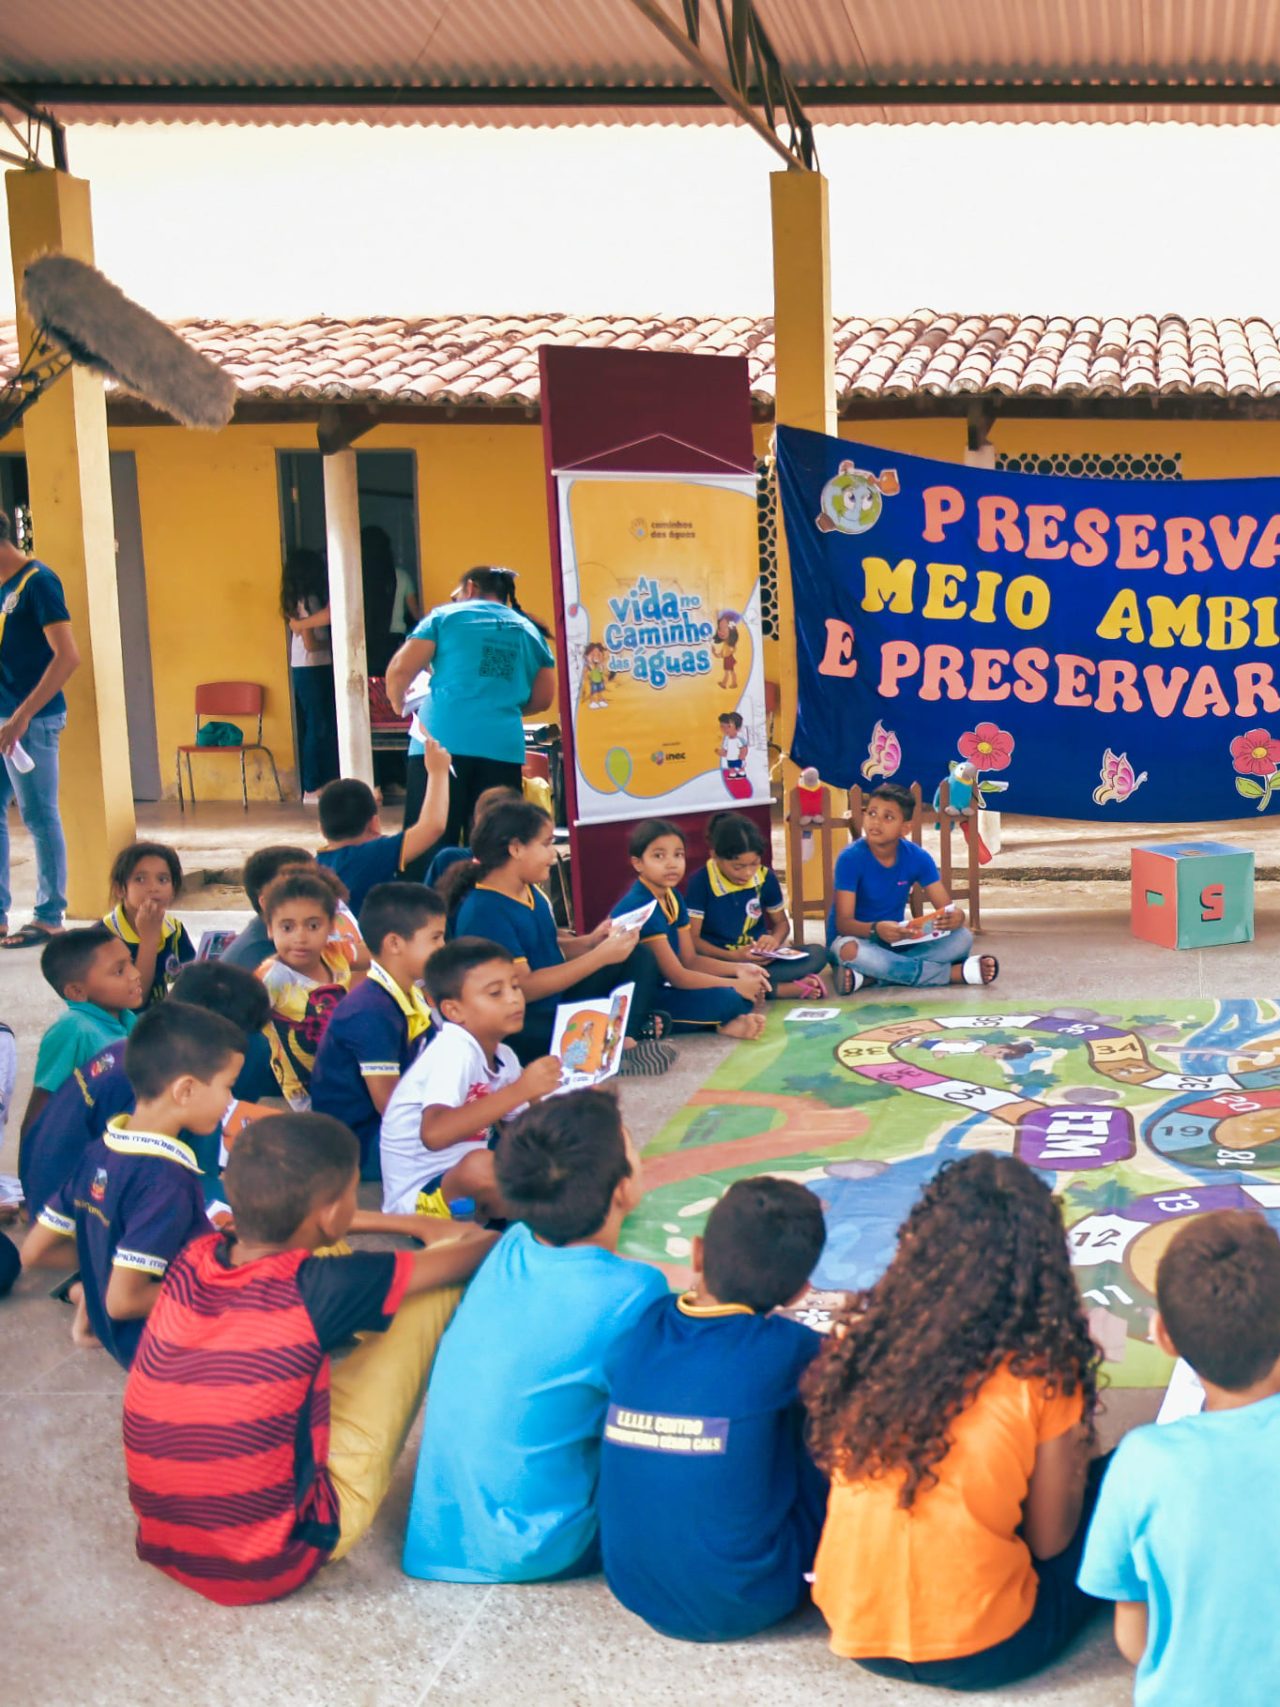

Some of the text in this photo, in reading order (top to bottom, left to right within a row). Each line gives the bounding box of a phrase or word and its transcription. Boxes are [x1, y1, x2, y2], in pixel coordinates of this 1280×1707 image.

[609, 580, 700, 624] vida no
[861, 557, 1051, 630] MEIO
[606, 613, 713, 652] Caminho
[818, 618, 859, 678] E
[609, 648, 711, 688] das águas
[1057, 1023, 1099, 1036] 35
[1096, 1043, 1139, 1054] 34
[1178, 1077, 1213, 1089] 32
[944, 1086, 986, 1100] 40
[1213, 1095, 1262, 1112] 20
[1038, 1110, 1113, 1159] FIM
[1160, 1126, 1204, 1137] 19
[1217, 1149, 1256, 1166] 18
[1153, 1193, 1200, 1212] 13
[1074, 1229, 1121, 1247] 12
[1082, 1285, 1133, 1306] 11
